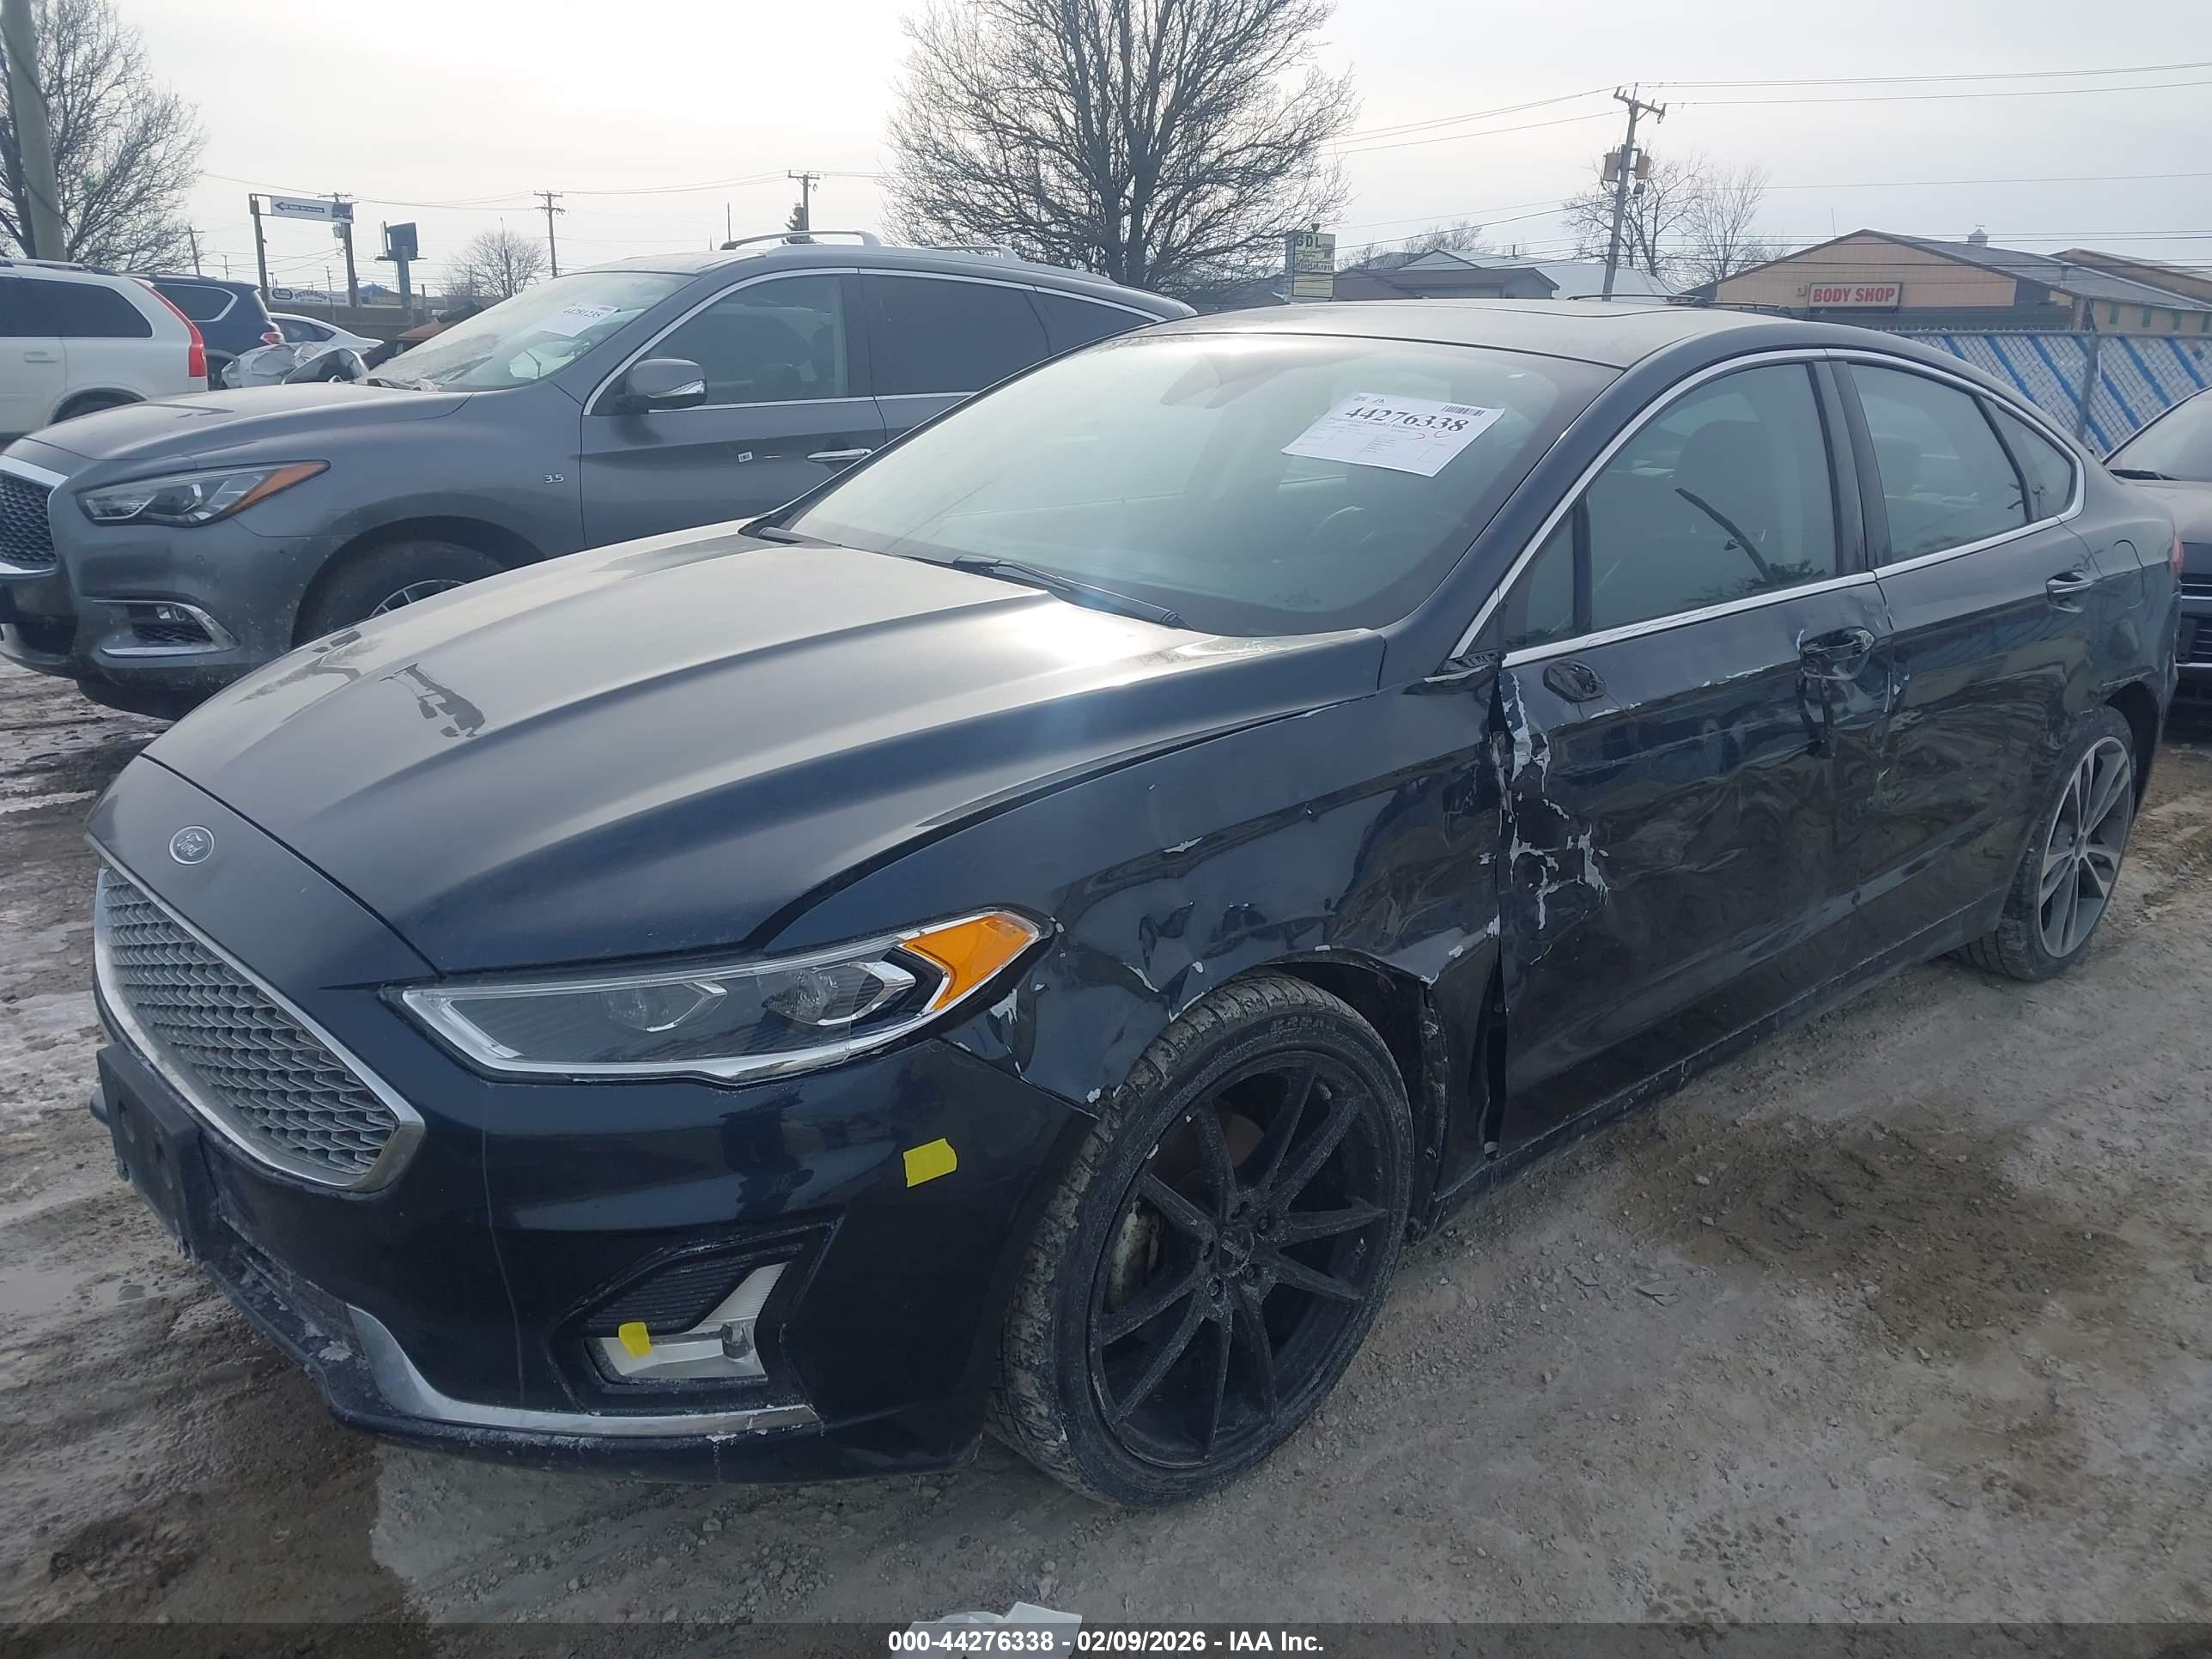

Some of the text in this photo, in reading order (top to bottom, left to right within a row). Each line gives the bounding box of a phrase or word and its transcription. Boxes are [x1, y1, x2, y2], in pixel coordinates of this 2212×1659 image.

[1297, 235, 1321, 248] GDL
[295, 290, 328, 301] PETERSON
[1814, 288, 1895, 302] BODY SHOP
[1345, 406, 1469, 433] 44276338
[544, 473, 564, 483] 3.5
